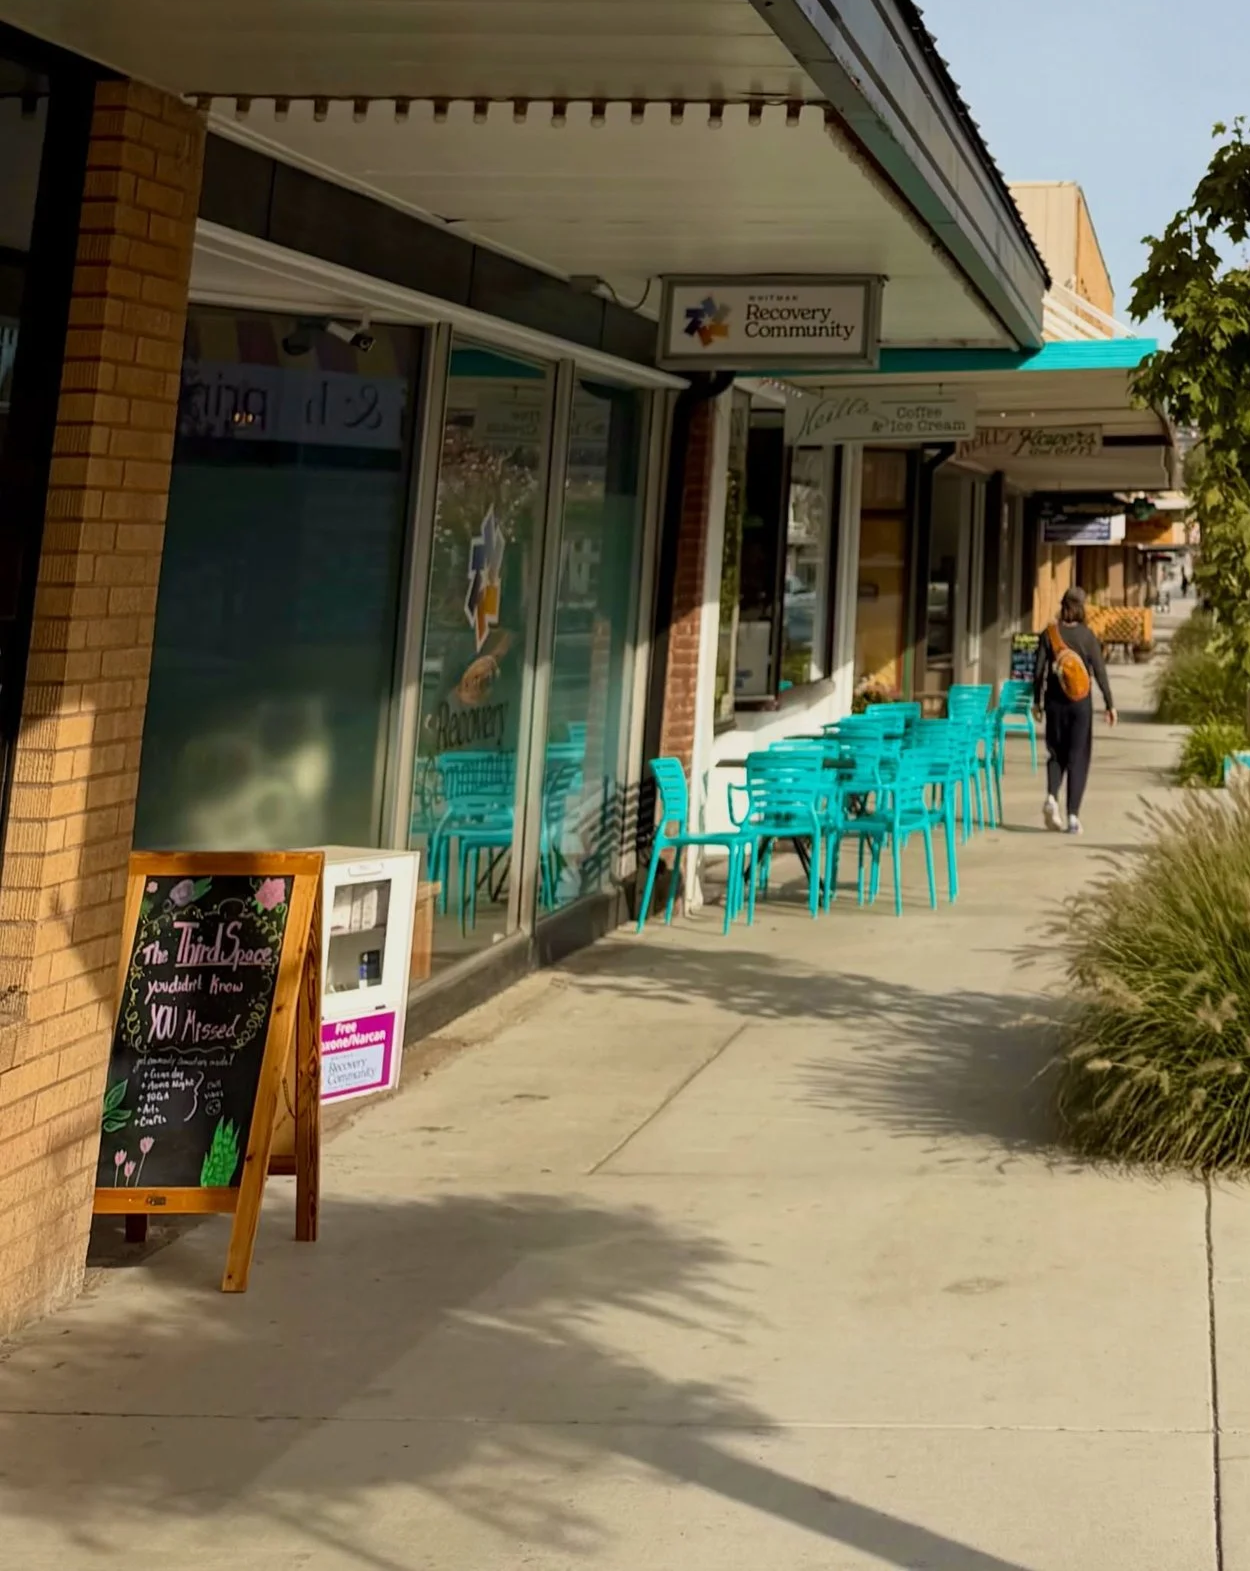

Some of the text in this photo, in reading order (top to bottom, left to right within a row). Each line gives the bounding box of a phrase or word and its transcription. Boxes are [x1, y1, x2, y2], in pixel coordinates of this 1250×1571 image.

[745, 304, 832, 324] Recovery
[744, 320, 855, 341] Community
[896, 406, 942, 419] Coffee
[891, 420, 913, 432] Ice
[917, 419, 966, 432] Cream
[142, 921, 272, 972] The Third Space
[144, 979, 169, 1005] you
[147, 1003, 241, 1044] YOU Missed
[335, 1021, 357, 1036] Free
